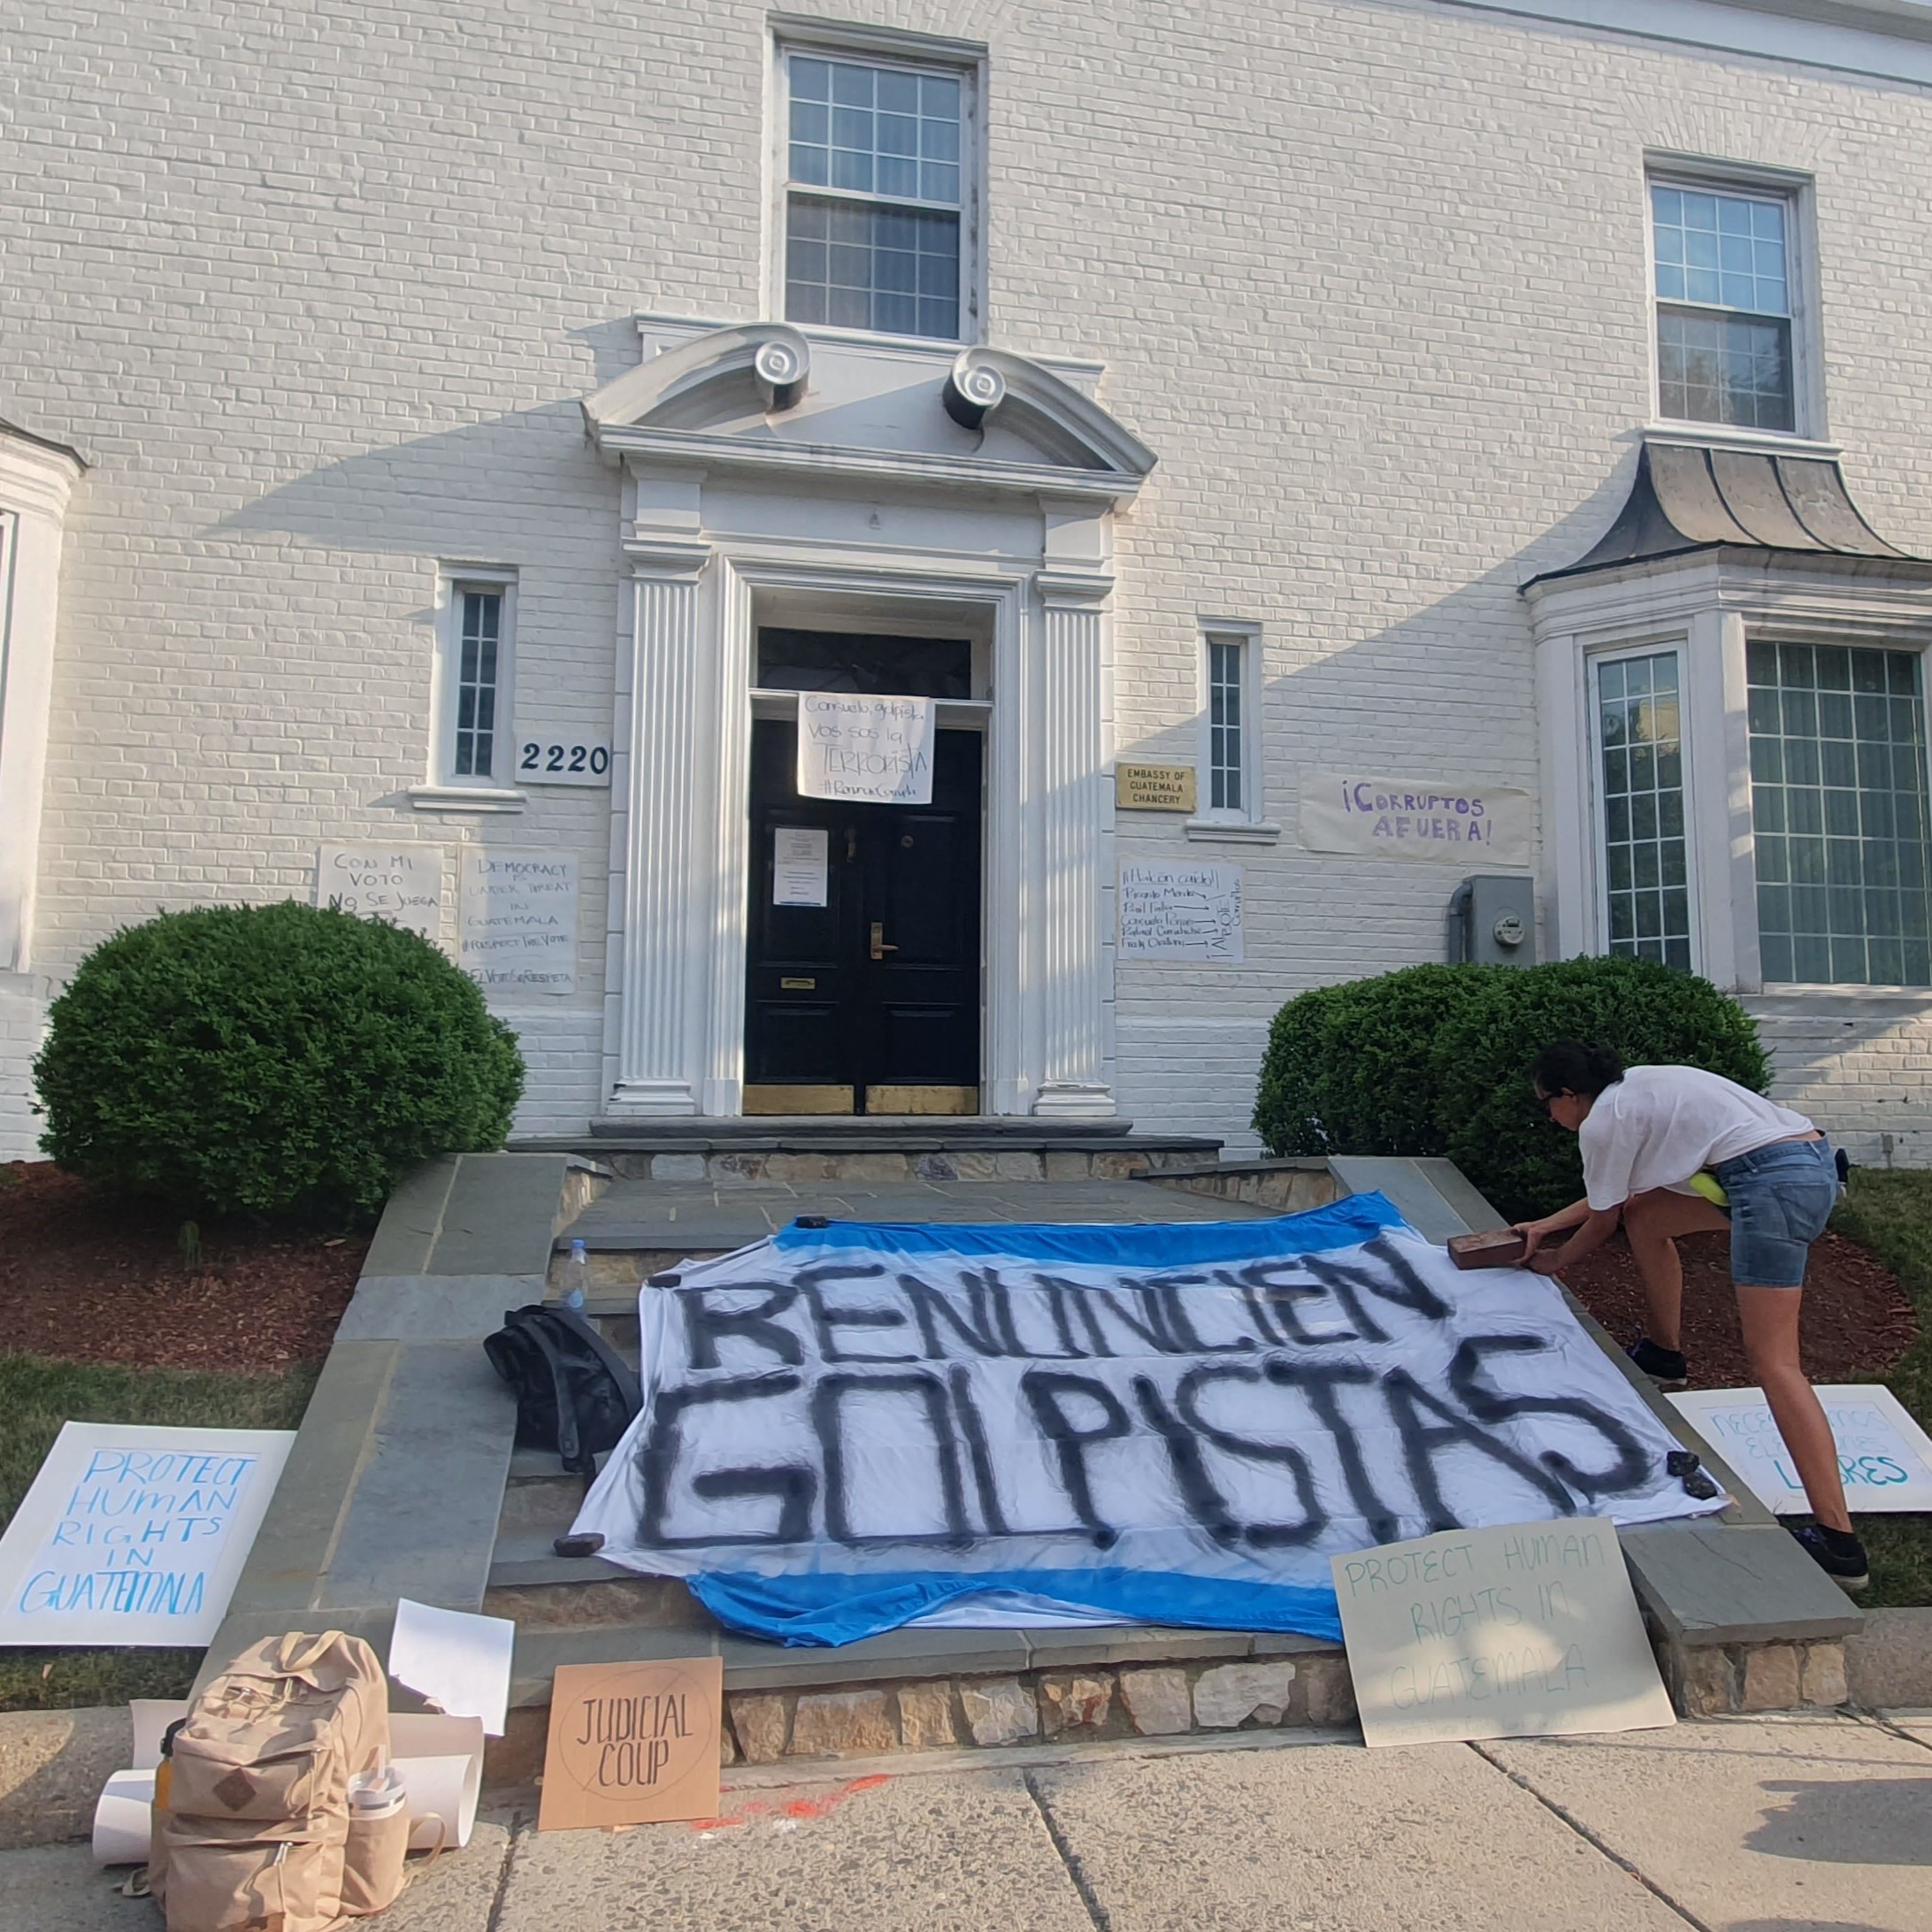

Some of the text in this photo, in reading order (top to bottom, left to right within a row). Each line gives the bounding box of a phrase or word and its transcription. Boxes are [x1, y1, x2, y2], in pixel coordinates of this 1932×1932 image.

[848, 726, 878, 739] sos
[886, 728, 902, 743] la
[520, 743, 609, 775] 2220
[813, 742, 927, 778] TERRORISTA
[1128, 769, 1185, 780] EMBASSY OF
[1130, 781, 1184, 793] GUATEMALA
[1132, 794, 1180, 804] CHANCERY
[1342, 779, 1484, 816] ¡CORRUPTOS
[1372, 816, 1492, 846] AFUERA!
[334, 853, 413, 870] CON MI
[478, 860, 567, 878] DEMOCRACY
[349, 873, 403, 886] VOTO
[469, 882, 571, 896] UNDER THREAT
[328, 891, 439, 911] NO SE JUEGA
[467, 916, 559, 927] GUATEMALA
[677, 1239, 1453, 1368] RENUNCIEN
[634, 1335, 1653, 1552] GOLPISTAS
[83, 1450, 258, 1485] PROTECT
[65, 1486, 237, 1516] HUMAN
[52, 1516, 223, 1546] RIGHTS
[106, 1548, 154, 1567] IN
[1345, 1533, 1605, 1597] PROTECT HUMAN
[19, 1570, 204, 1614] GUATEMALA
[1410, 1580, 1572, 1645] RIGHTS IN
[1391, 1643, 1590, 1710] GUATEMALA
[576, 1693, 694, 1745] JUDICIAL
[598, 1739, 670, 1787] COUP
